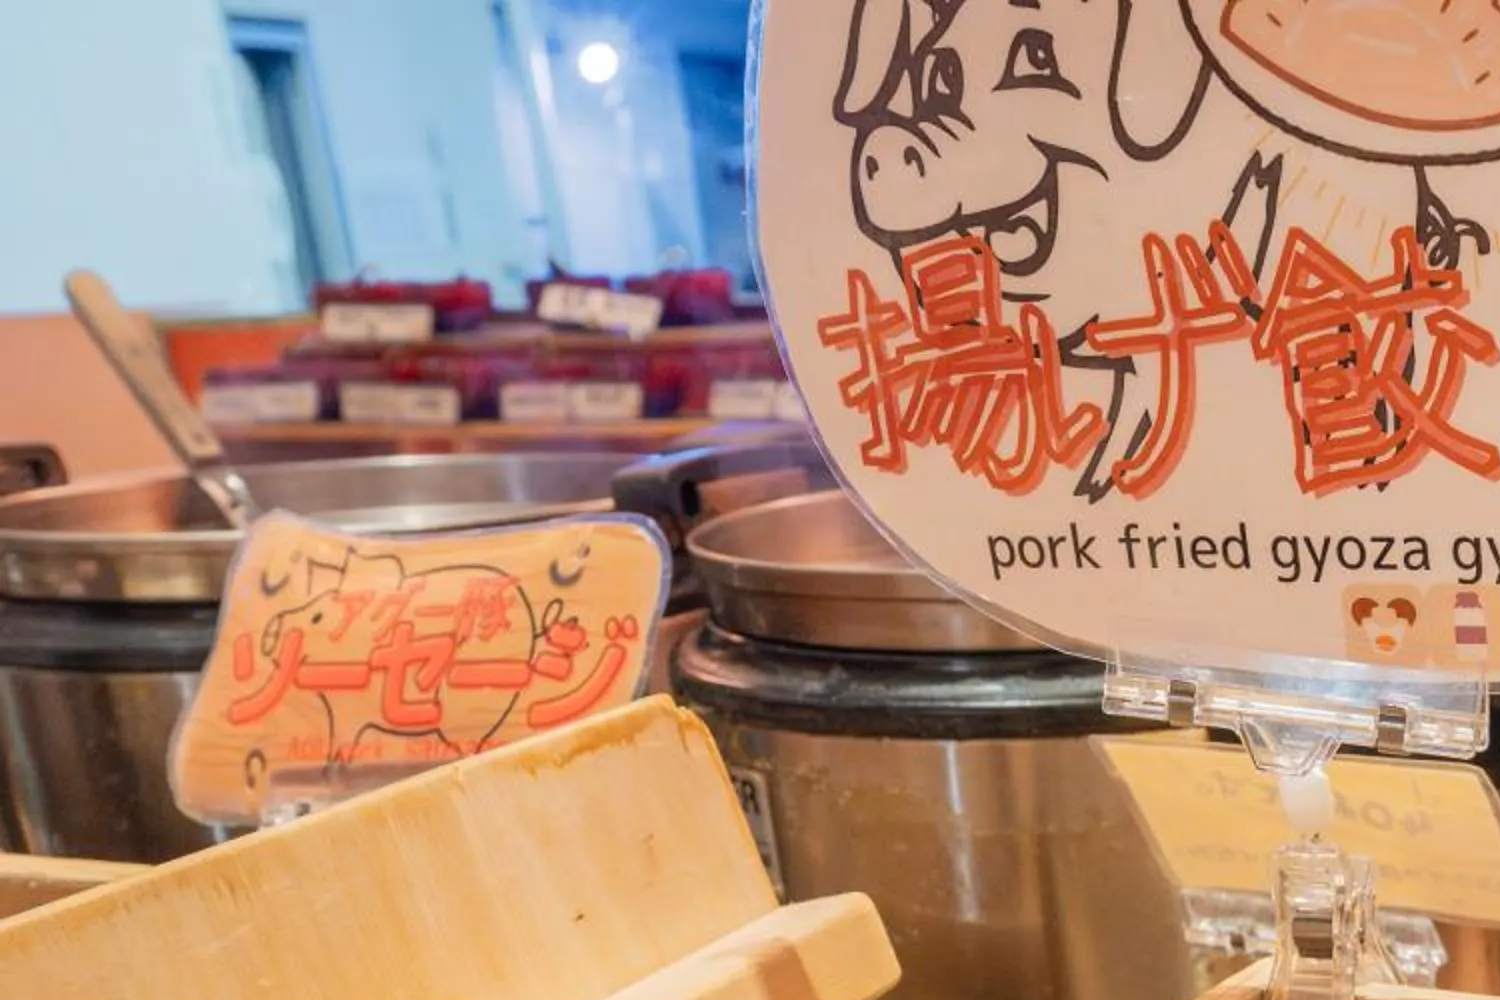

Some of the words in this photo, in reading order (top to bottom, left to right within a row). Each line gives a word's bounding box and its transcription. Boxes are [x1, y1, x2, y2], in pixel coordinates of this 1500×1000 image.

[986, 523, 1101, 580] pork
[1117, 523, 1251, 570] fried
[1270, 534, 1431, 583] gyoza
[226, 613, 640, 729] ソーセージ
